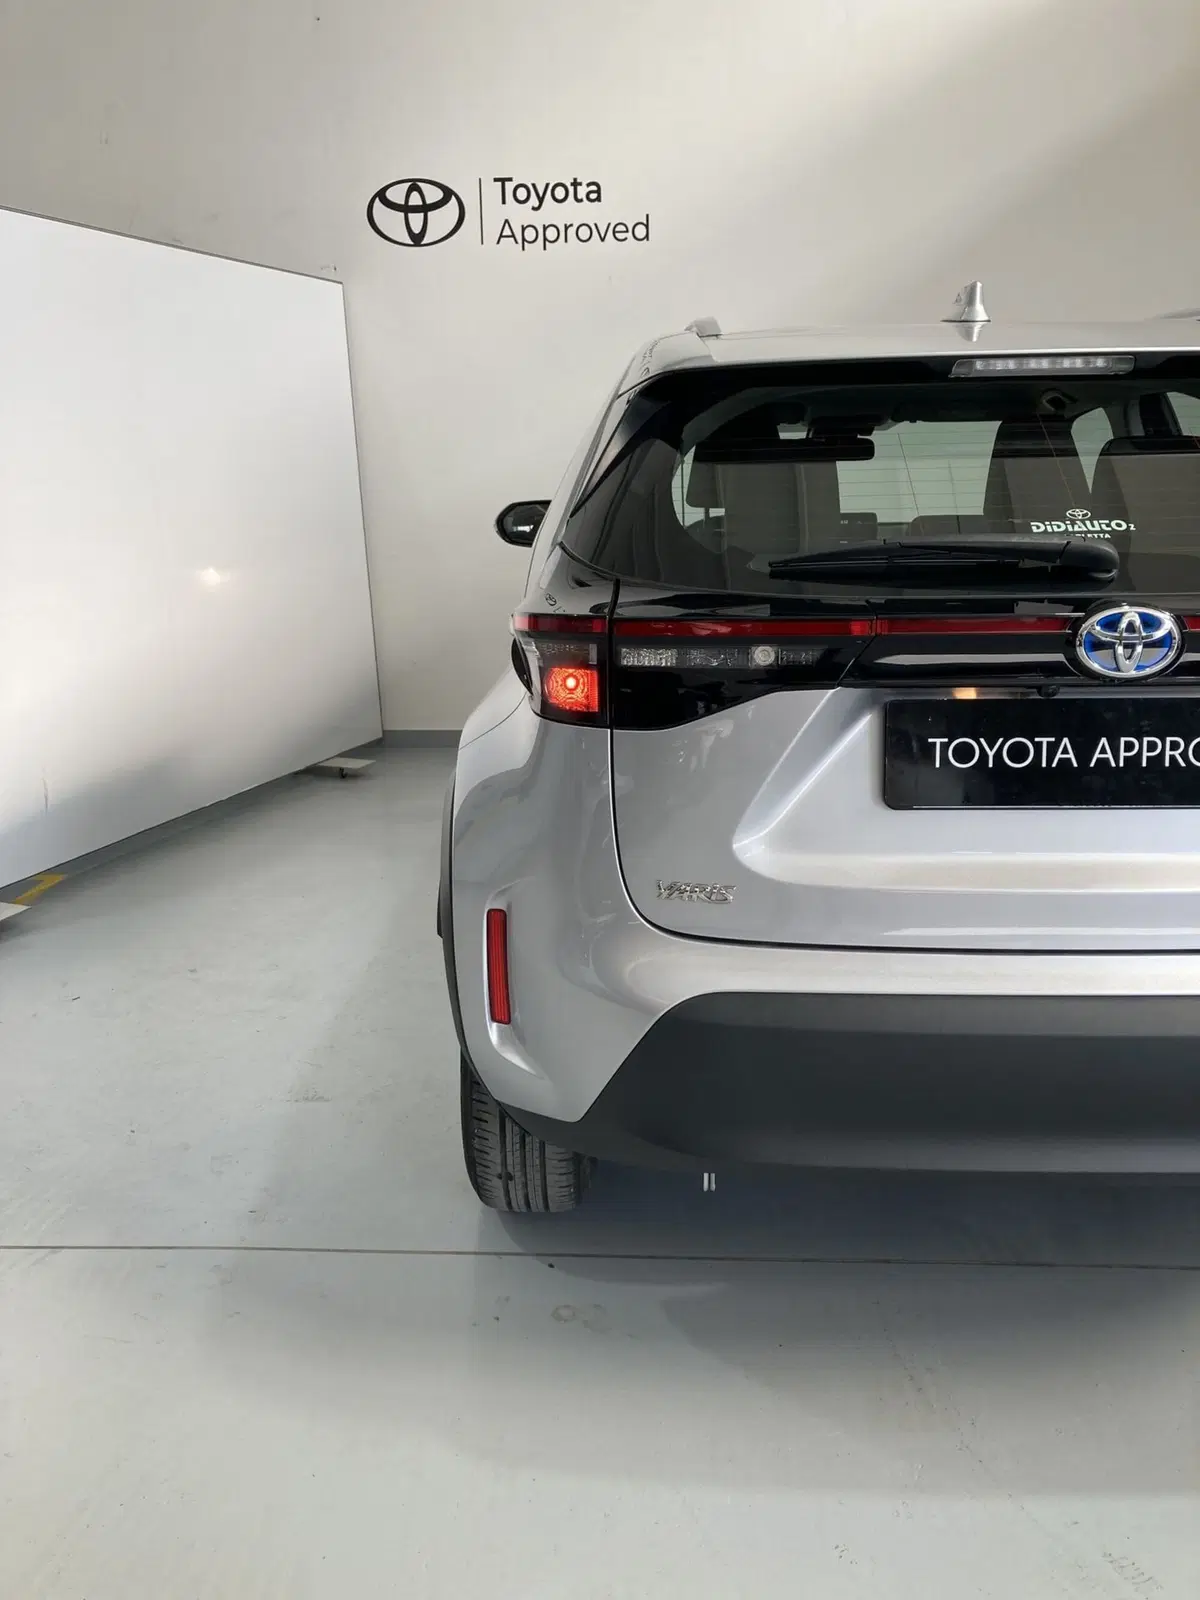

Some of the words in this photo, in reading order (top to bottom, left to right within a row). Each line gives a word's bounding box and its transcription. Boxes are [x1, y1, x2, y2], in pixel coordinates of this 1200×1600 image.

[493, 177, 602, 211] Toyota
[496, 213, 650, 251] Approved
[927, 737, 1078, 768] TOYOTA
